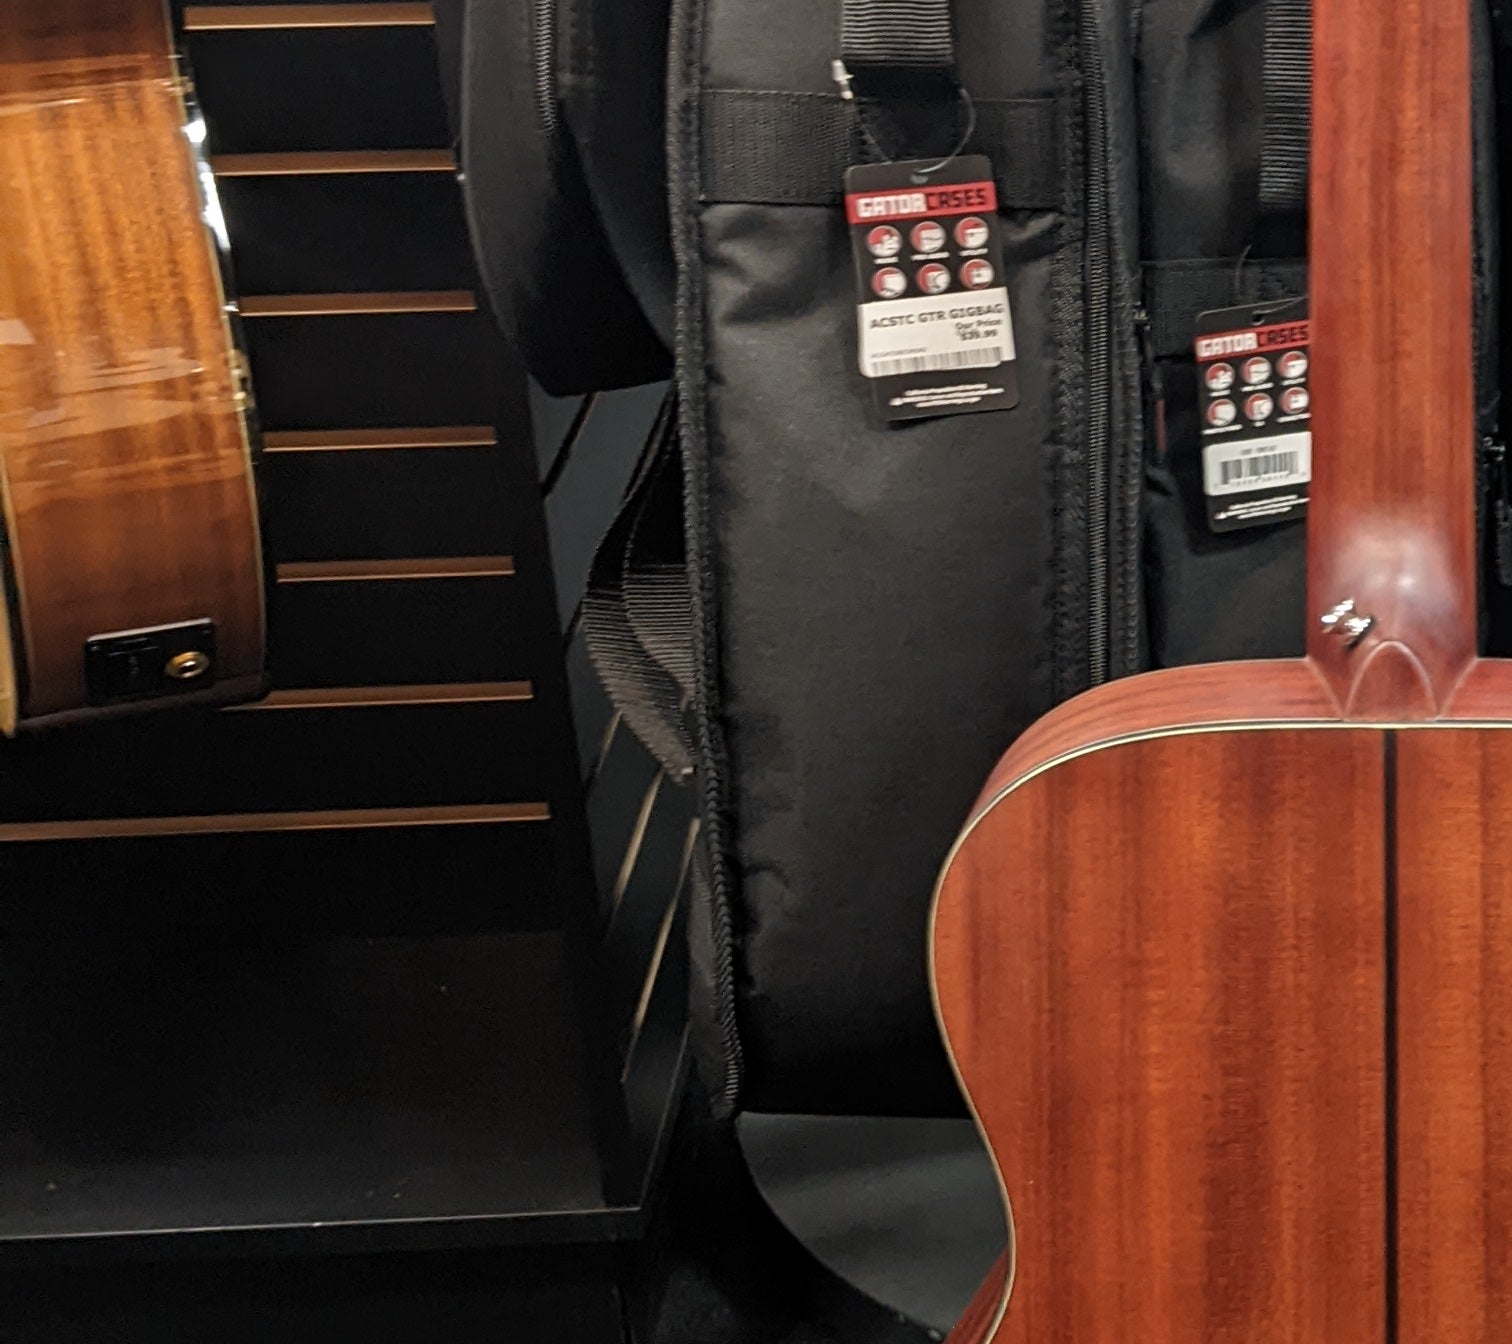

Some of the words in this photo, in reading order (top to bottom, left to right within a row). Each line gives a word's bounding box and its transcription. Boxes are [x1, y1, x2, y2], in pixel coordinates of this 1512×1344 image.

[870, 314, 915, 329] ACSTC
[918, 310, 947, 323] GTR
[949, 303, 1005, 319] GIGBAG
